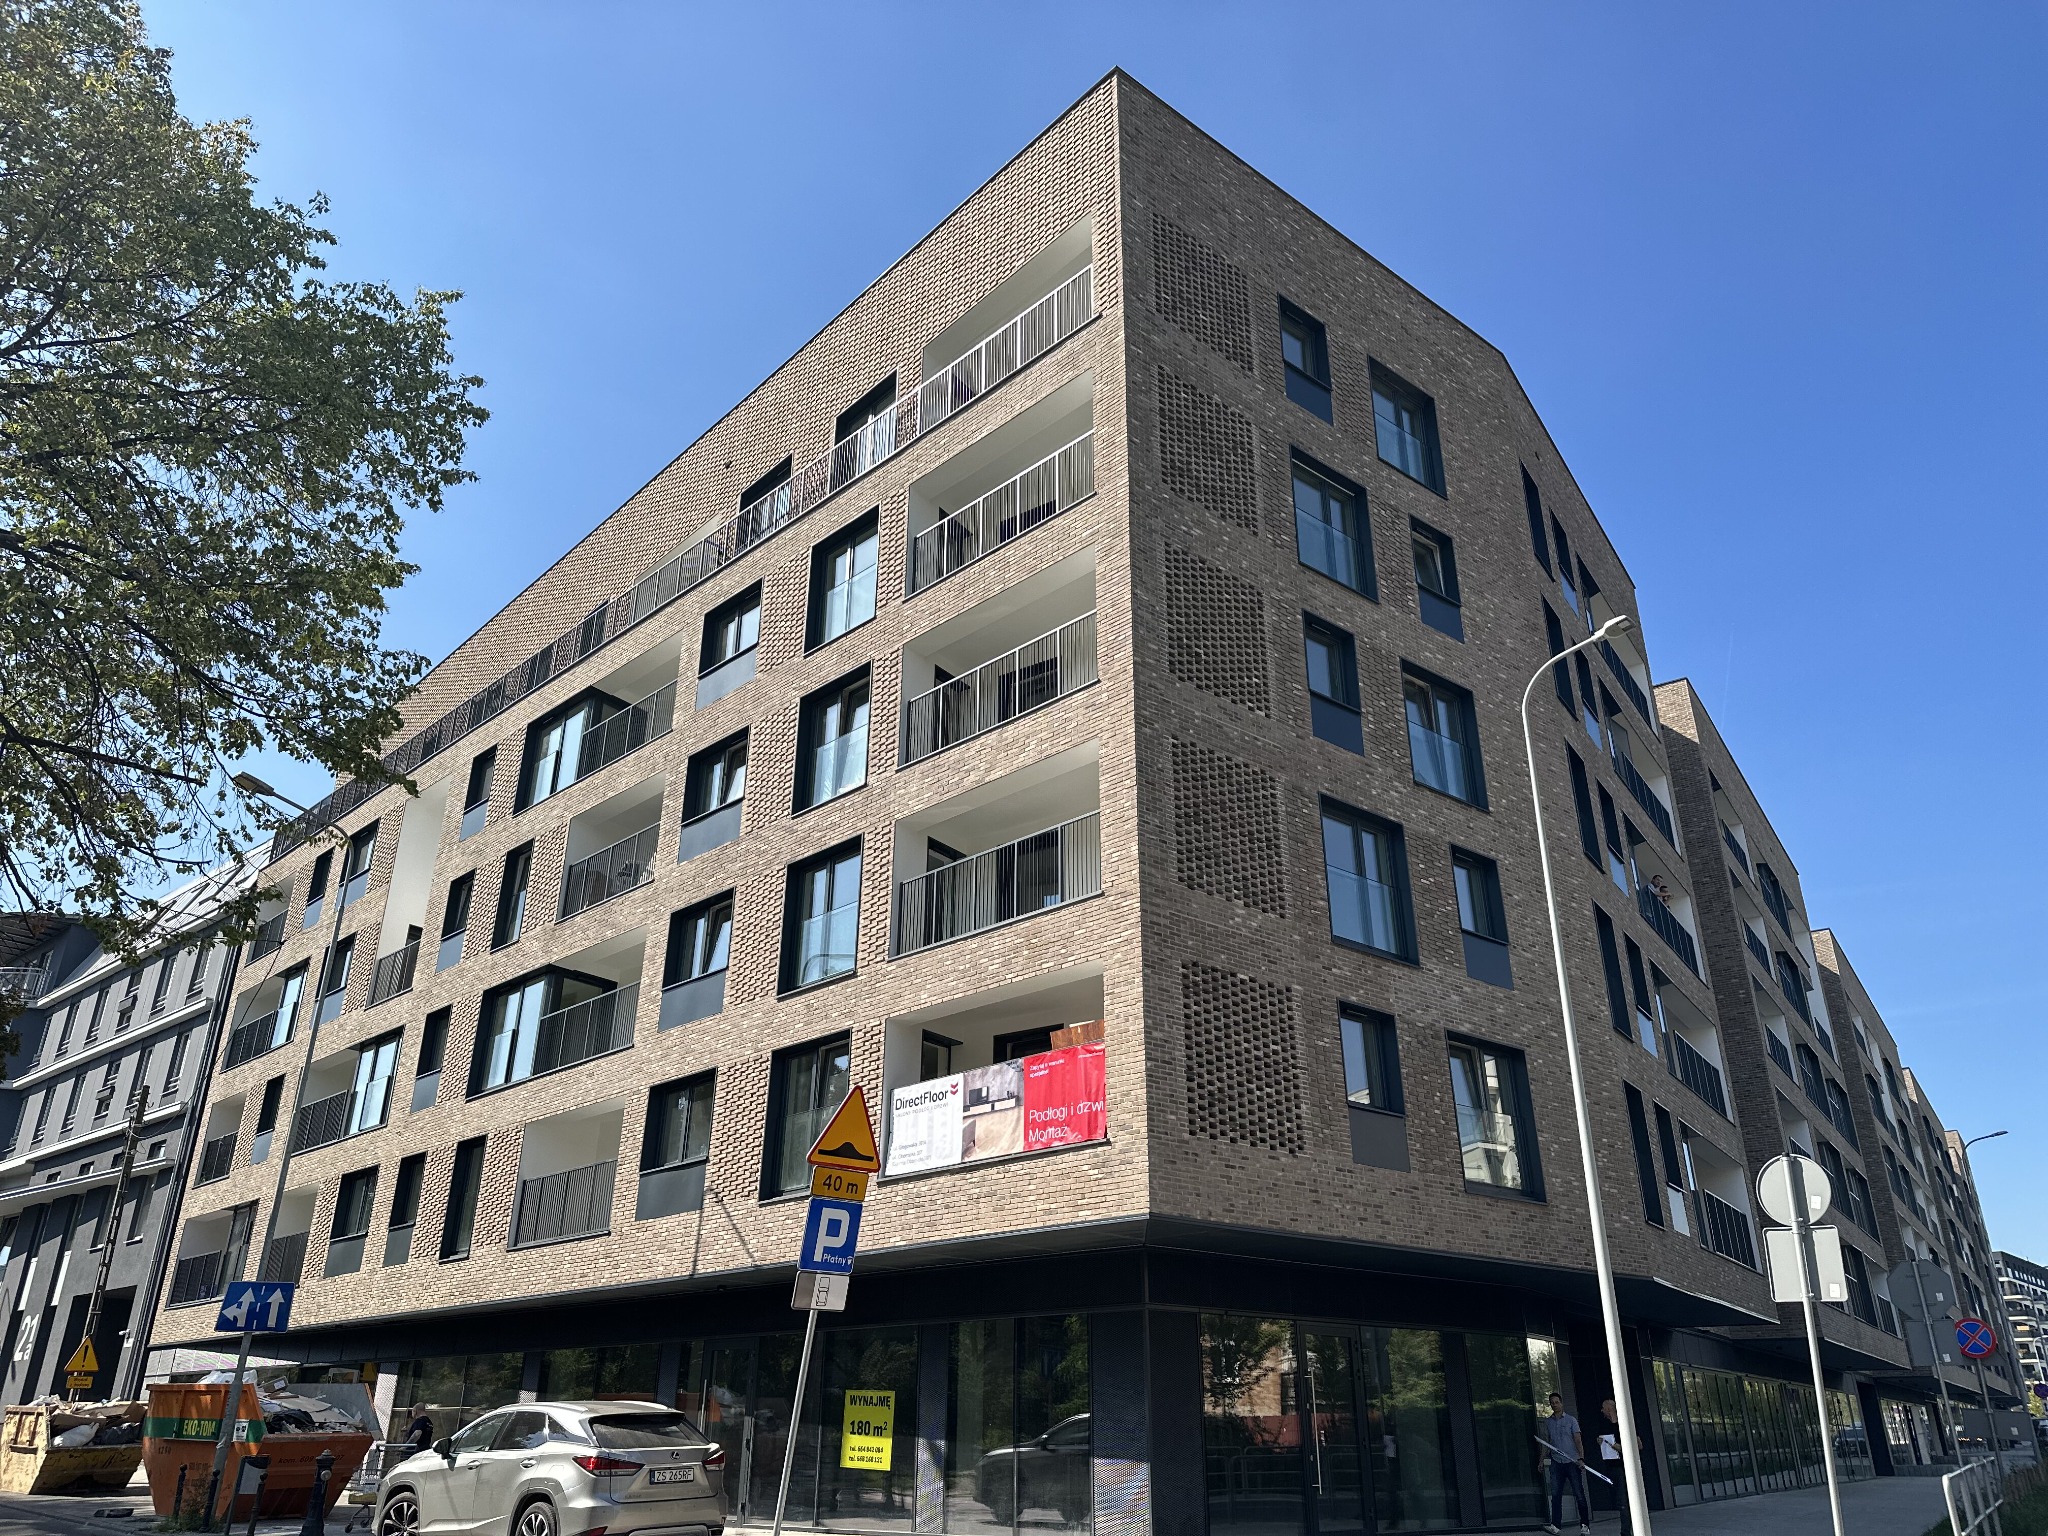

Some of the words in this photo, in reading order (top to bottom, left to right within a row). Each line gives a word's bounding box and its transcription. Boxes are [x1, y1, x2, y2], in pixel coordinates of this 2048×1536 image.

[895, 1089, 949, 1111] DirectFloor
[1029, 1103, 1068, 1123] Podłogi
[1070, 1102, 1074, 1116] i
[822, 1173, 843, 1192] 40
[845, 1180, 859, 1195] m
[813, 1207, 850, 1262] P
[822, 1253, 848, 1266] Płatny
[849, 1394, 891, 1410] WYNAJMĘ
[849, 1419, 871, 1436] 180
[656, 1471, 667, 1481] ZS
